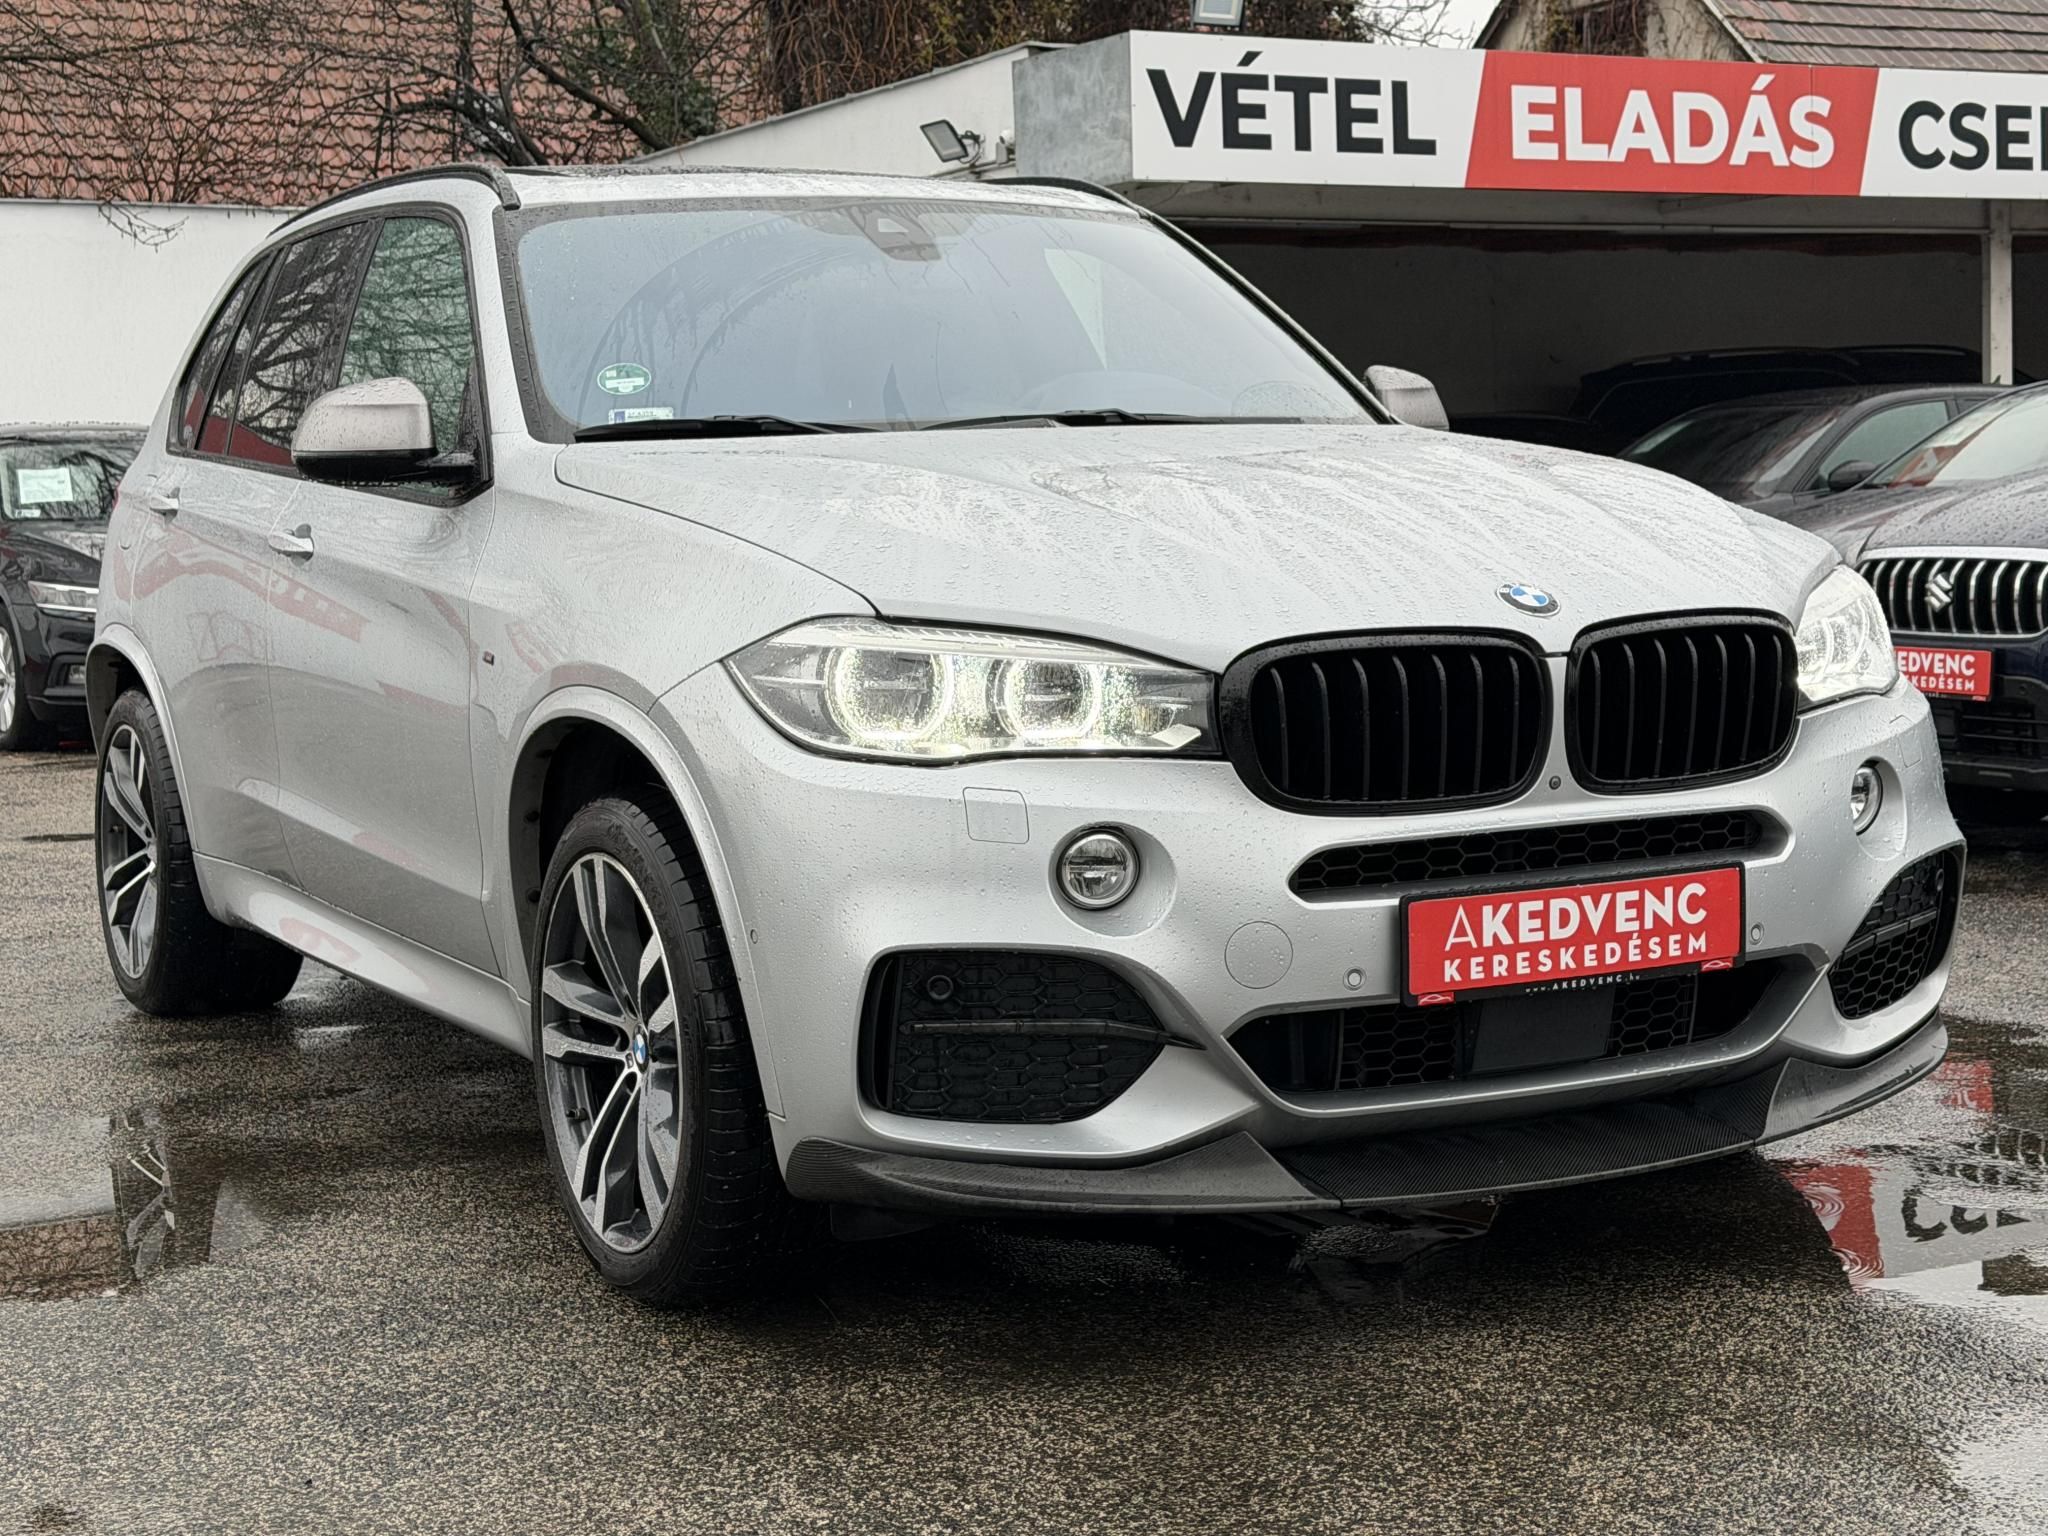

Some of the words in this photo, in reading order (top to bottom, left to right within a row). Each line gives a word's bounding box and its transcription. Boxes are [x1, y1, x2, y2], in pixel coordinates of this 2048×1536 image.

[1146, 50, 1437, 156] VÉTEL
[1511, 73, 1835, 169] ELADÁS
[1898, 100, 2048, 171] CSE
[1896, 651, 1975, 676] EDVENC
[1443, 930, 1707, 983] KERESKEDÉSEM
